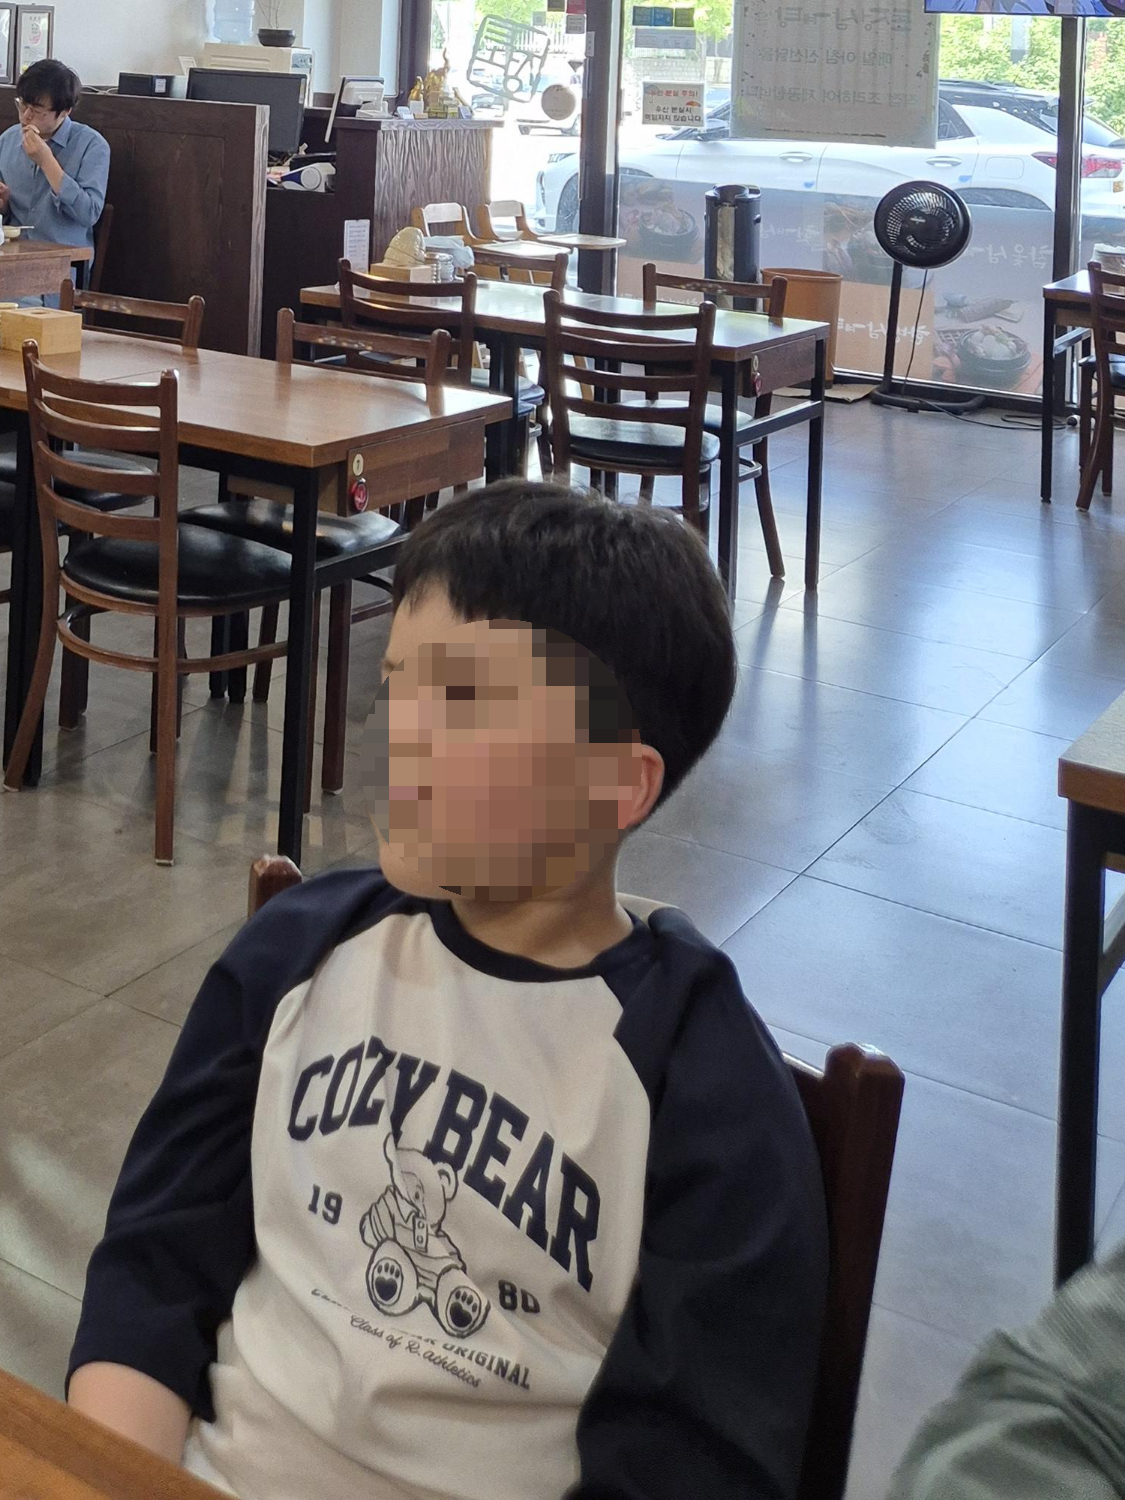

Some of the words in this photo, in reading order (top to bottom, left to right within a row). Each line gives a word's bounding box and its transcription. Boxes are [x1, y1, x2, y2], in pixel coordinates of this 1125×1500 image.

[682, 90, 698, 98] 주의!
[645, 113, 671, 121] 책임지지
[656, 105, 669, 113] 우산
[287, 1035, 440, 1148] COZY
[423, 1068, 601, 1293] BEAR
[308, 1184, 343, 1225] 19
[350, 1314, 384, 1339] Class
[385, 1334, 401, 1349] of
